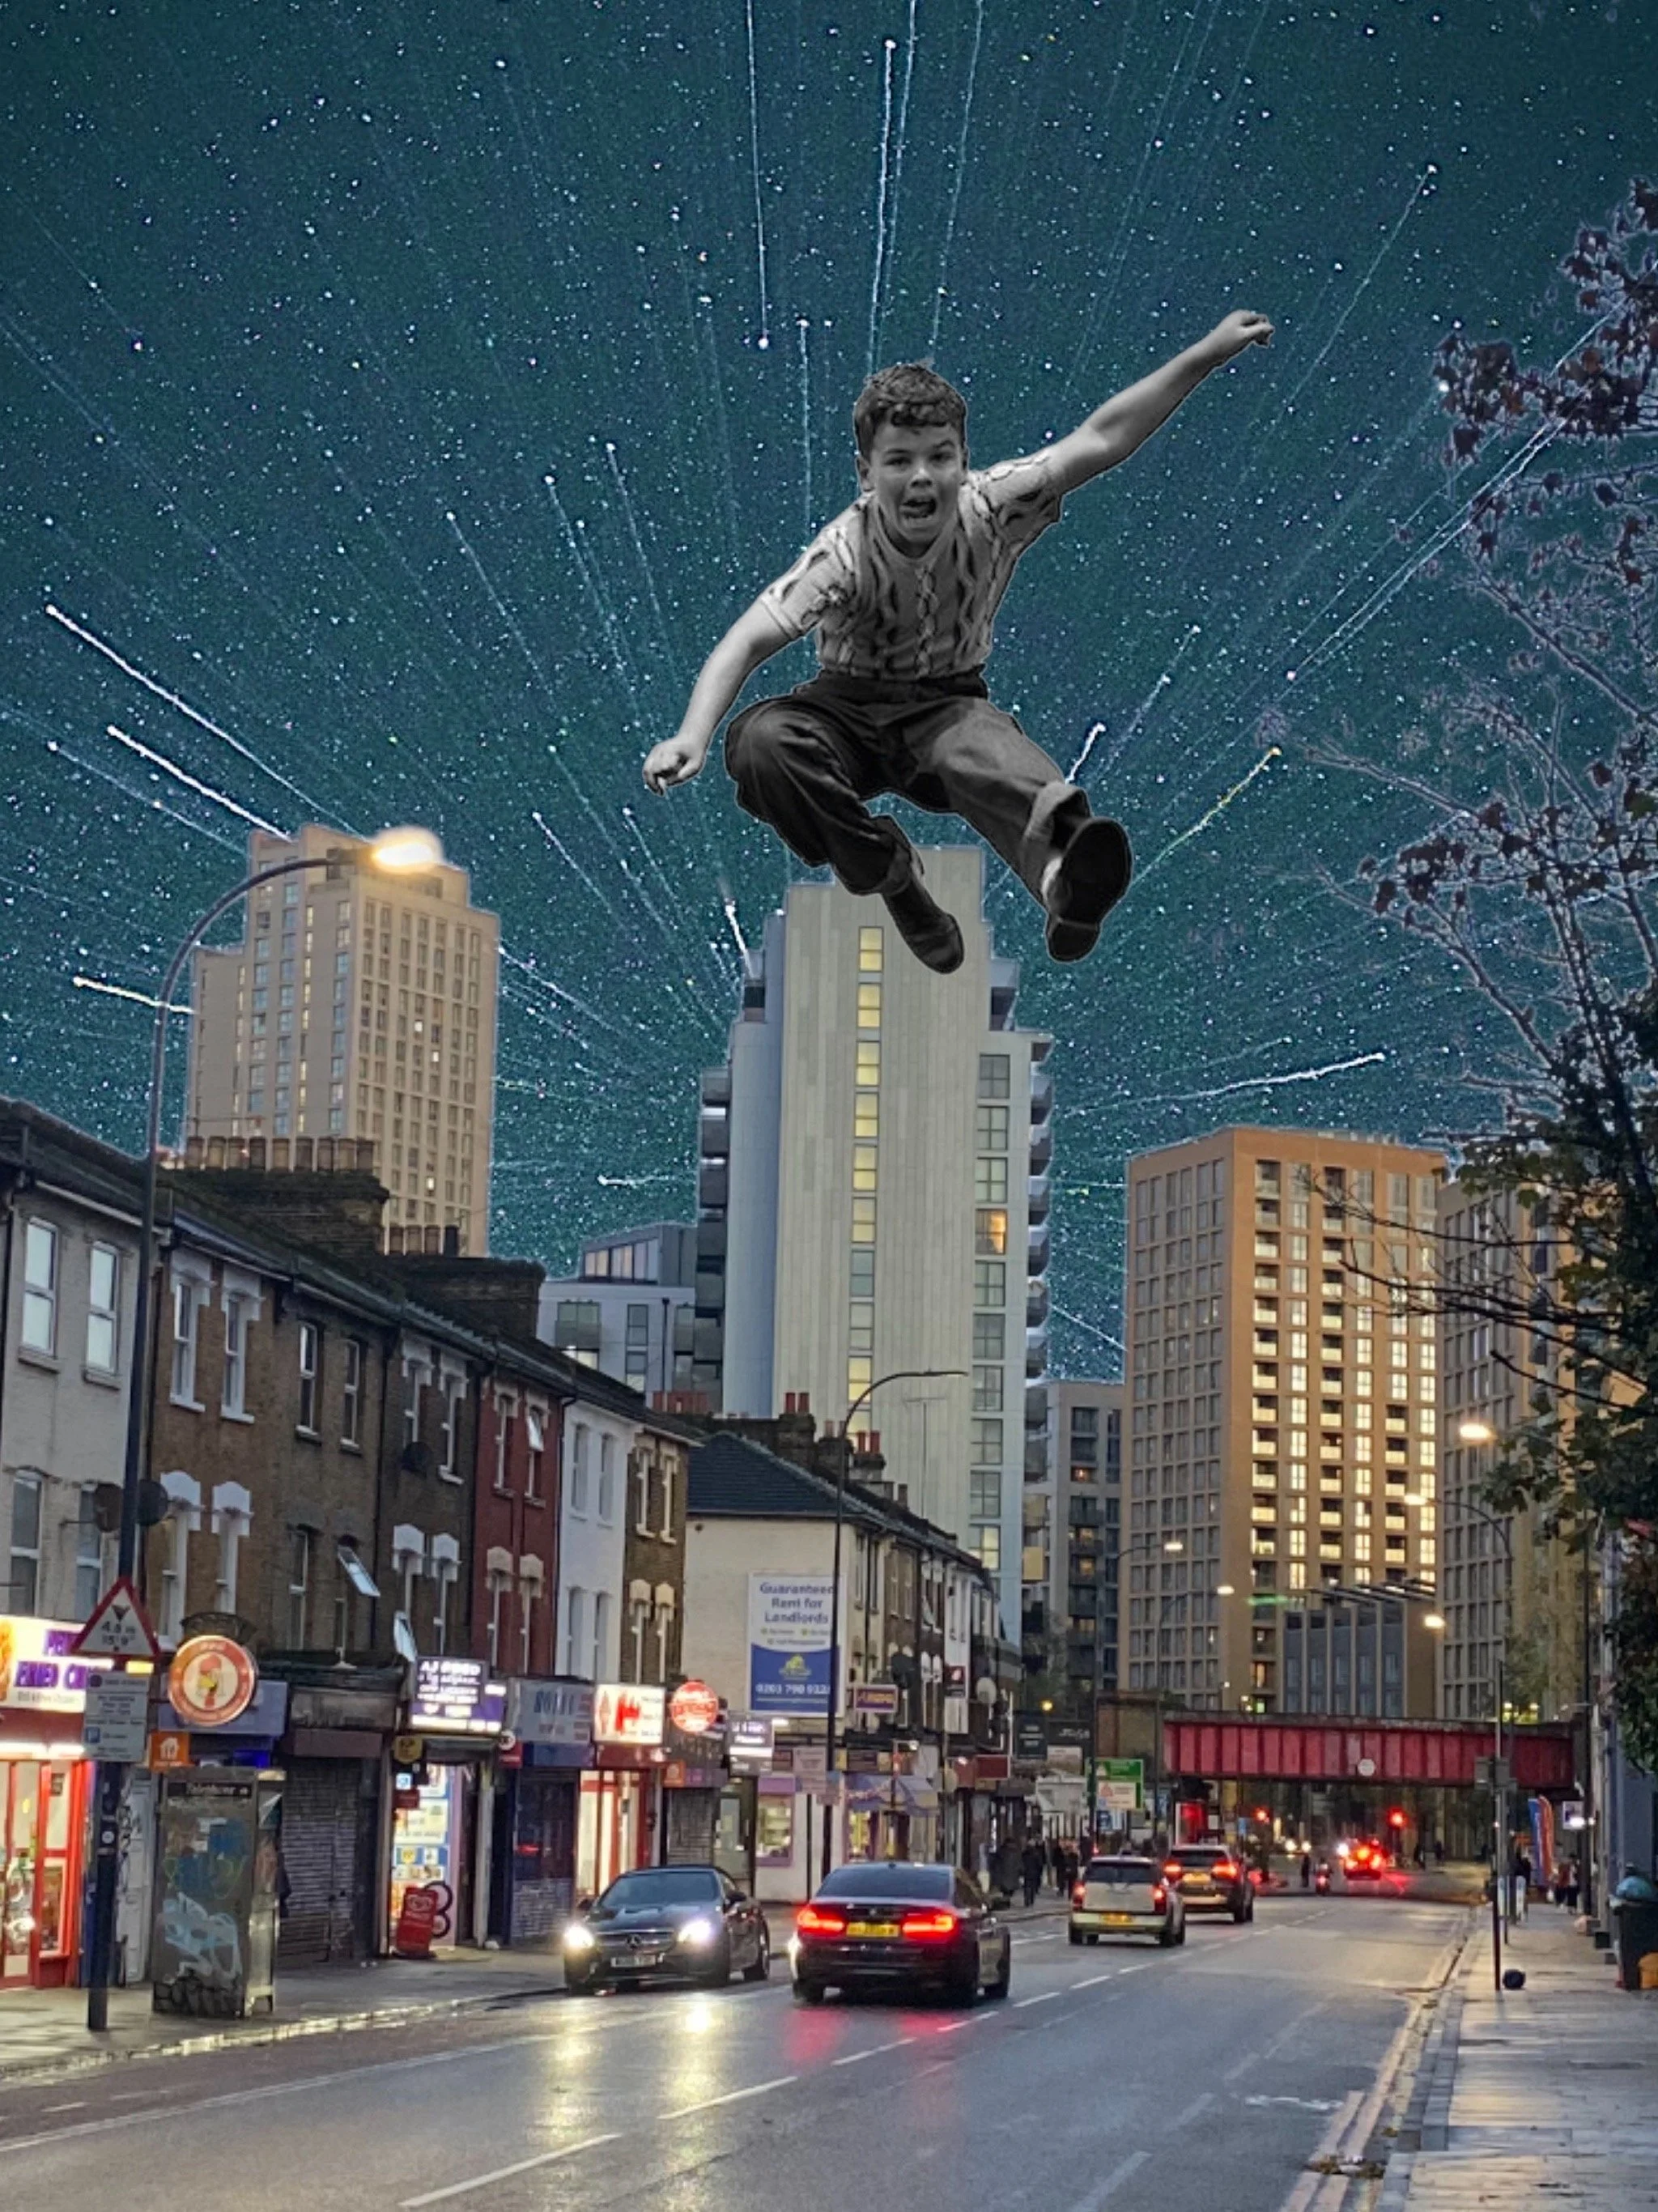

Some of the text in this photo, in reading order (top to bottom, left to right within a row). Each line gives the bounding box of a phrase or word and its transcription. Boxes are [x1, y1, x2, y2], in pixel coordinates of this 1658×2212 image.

[772, 1597, 823, 1608] Rent for
[764, 1612, 828, 1623] Landlords
